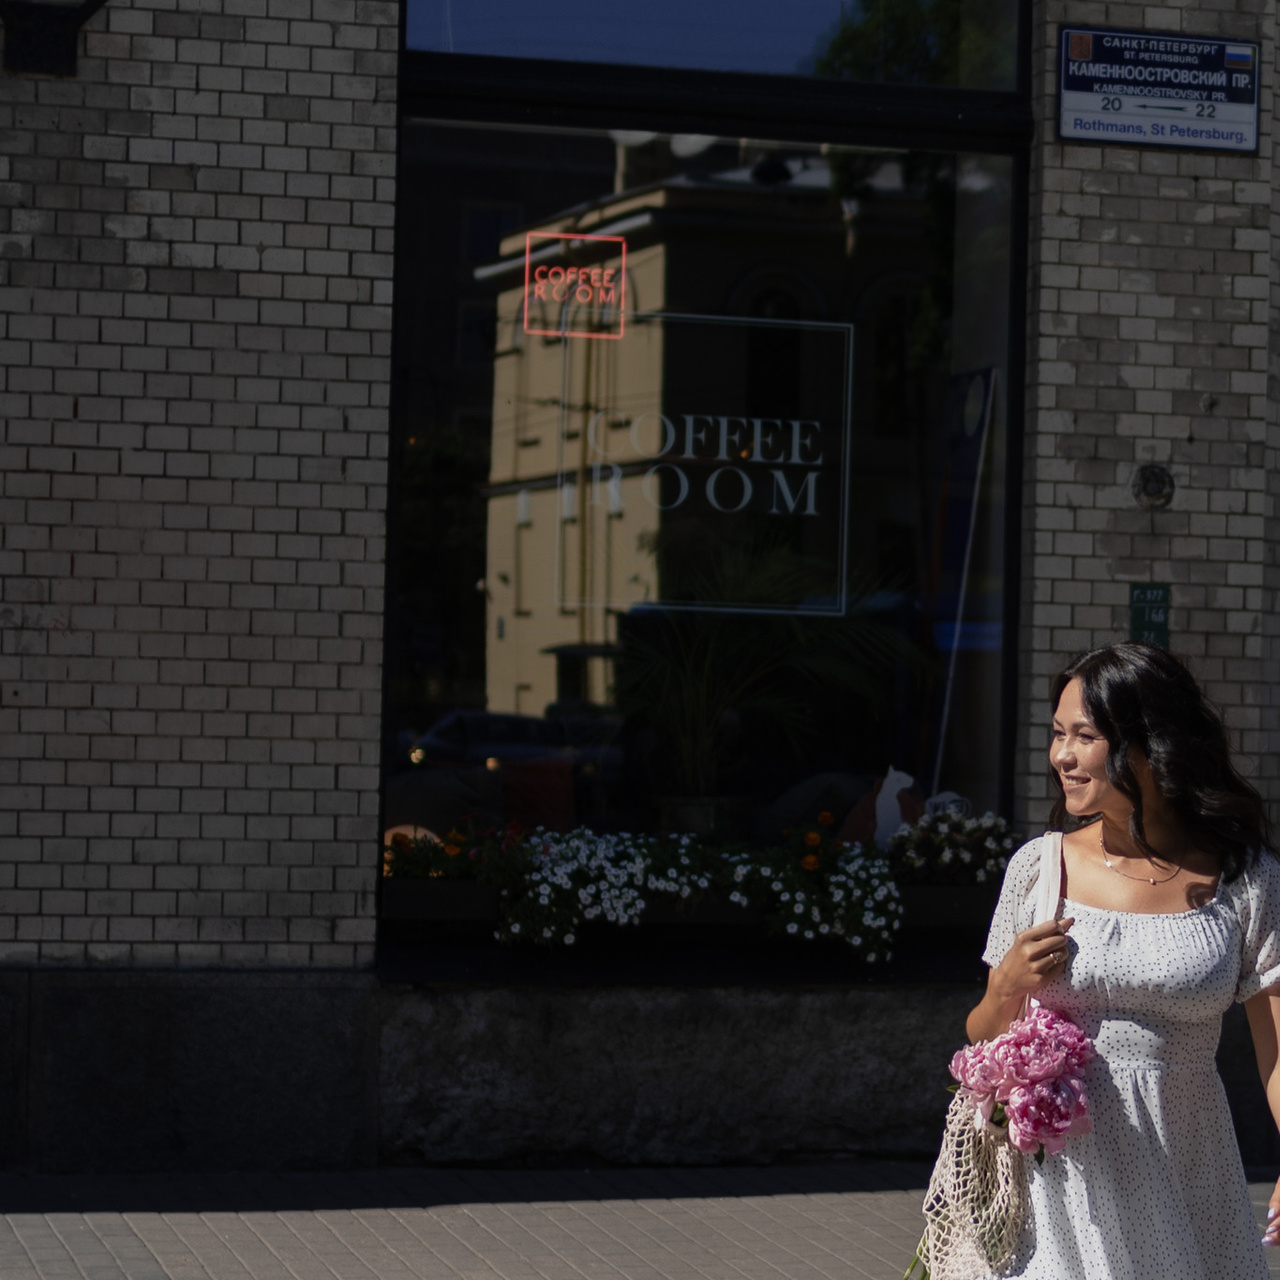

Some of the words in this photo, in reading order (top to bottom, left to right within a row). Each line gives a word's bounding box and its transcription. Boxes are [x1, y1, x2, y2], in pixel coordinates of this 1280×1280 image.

[1102, 36, 1219, 56] САНКТ-ПЕТЕРБУРГ
[1138, 52, 1199, 65] PETERSBURG
[1068, 61, 1227, 88] КАМЕННООСТРОВСКИЙ
[1231, 73, 1252, 89] ПР.
[1092, 82, 1208, 100] KAMENNOOSTROVSKY
[1211, 91, 1228, 103] PR.
[1101, 97, 1122, 112] 20
[1196, 103, 1216, 118] 22
[1073, 118, 1147, 137] Rothmans,
[1151, 124, 1165, 136] St
[1169, 125, 1248, 144] Petersburg.
[534, 265, 616, 289] COFFEE
[534, 283, 616, 305] ROOM
[586, 410, 824, 466] COFFEE
[588, 461, 821, 517] ROOM
